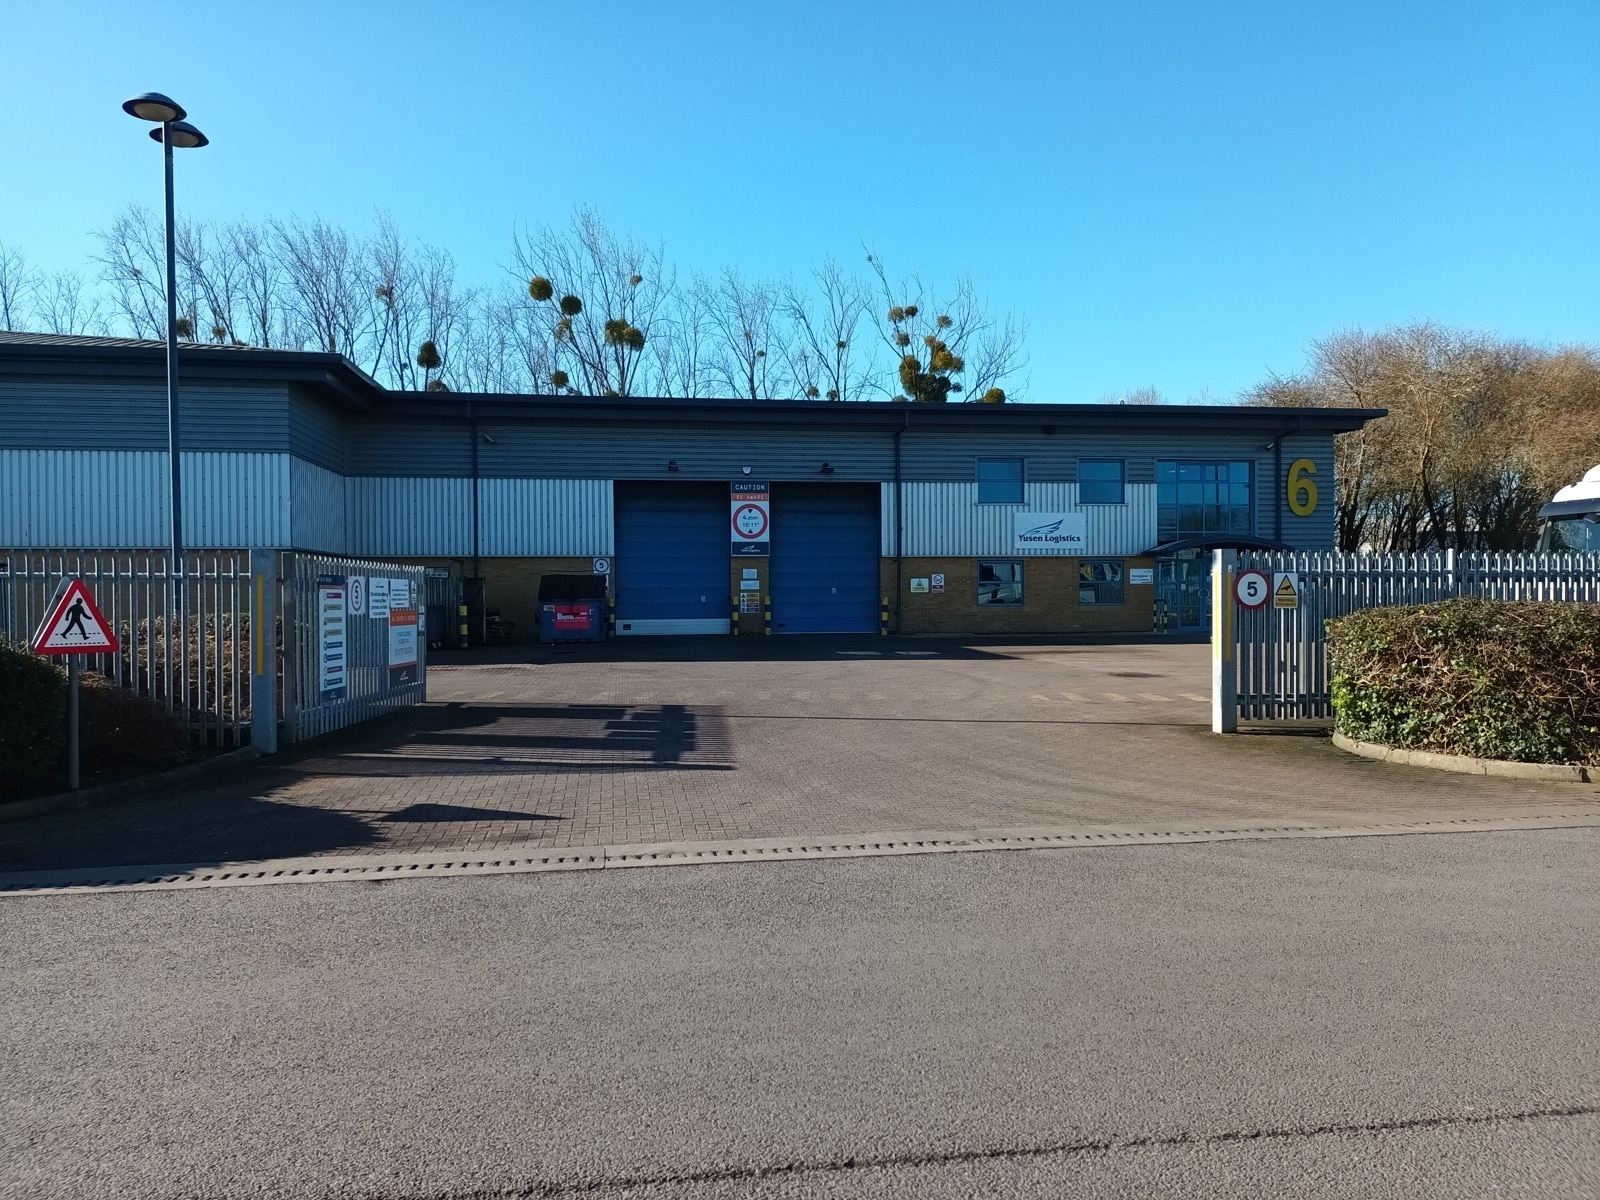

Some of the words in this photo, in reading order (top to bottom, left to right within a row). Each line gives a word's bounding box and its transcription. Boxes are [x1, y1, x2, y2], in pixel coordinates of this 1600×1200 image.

[1287, 457, 1318, 517] 6
[1018, 534, 1043, 542] Yusen
[1045, 534, 1081, 544] Logistics
[354, 585, 359, 600] 5
[1247, 581, 1258, 597] 5
